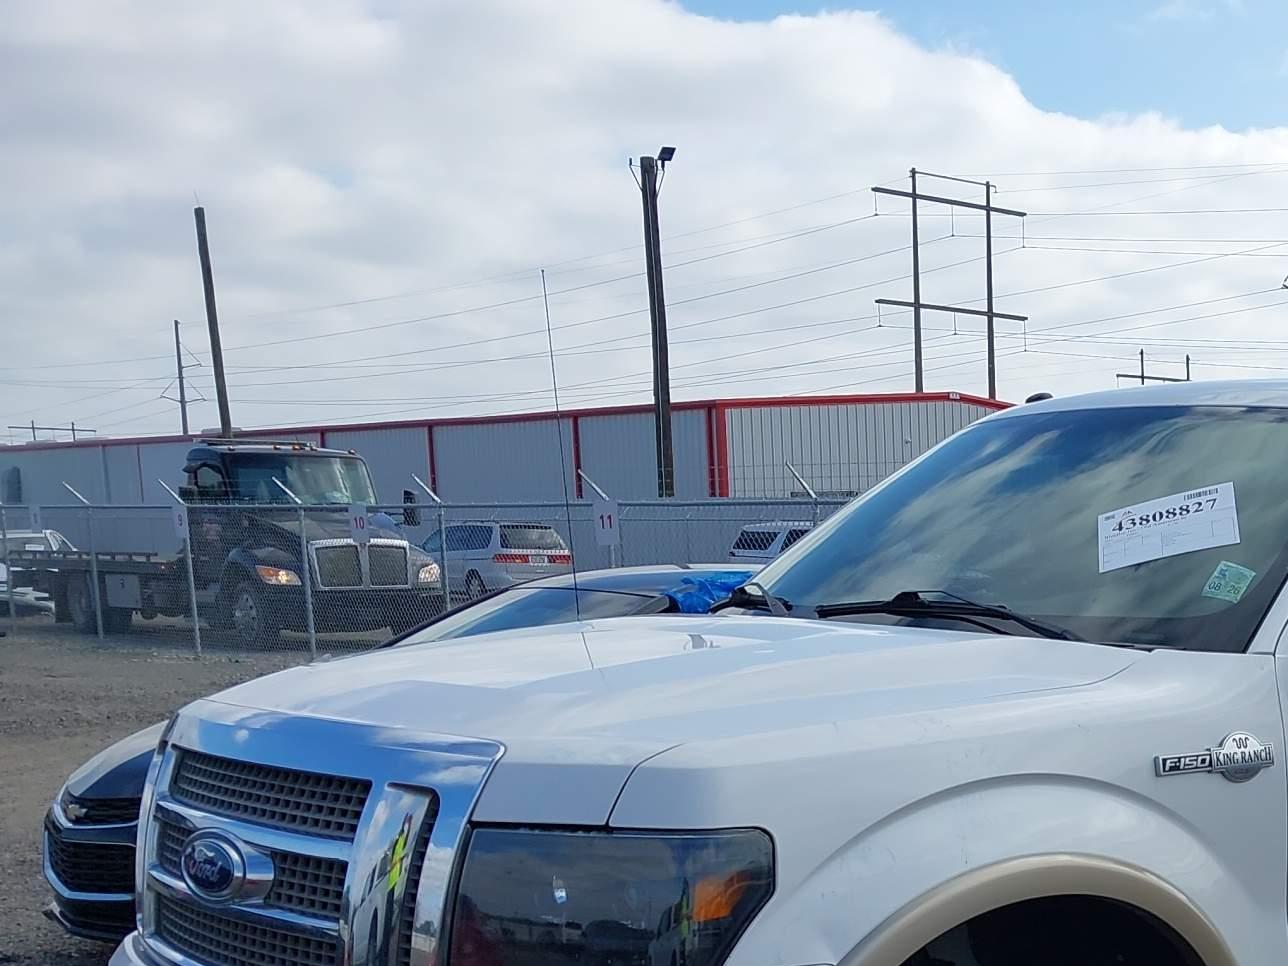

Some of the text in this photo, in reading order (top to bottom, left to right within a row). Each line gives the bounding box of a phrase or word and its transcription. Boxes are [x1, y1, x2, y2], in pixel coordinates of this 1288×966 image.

[353, 516, 366, 530] 10
[599, 513, 613, 530] 11
[1111, 498, 1218, 532] 43808827
[1208, 581, 1222, 591] 08
[1164, 755, 1211, 771] F-150
[1214, 746, 1272, 767] KING RANCH
[187, 846, 223, 883] Ford
